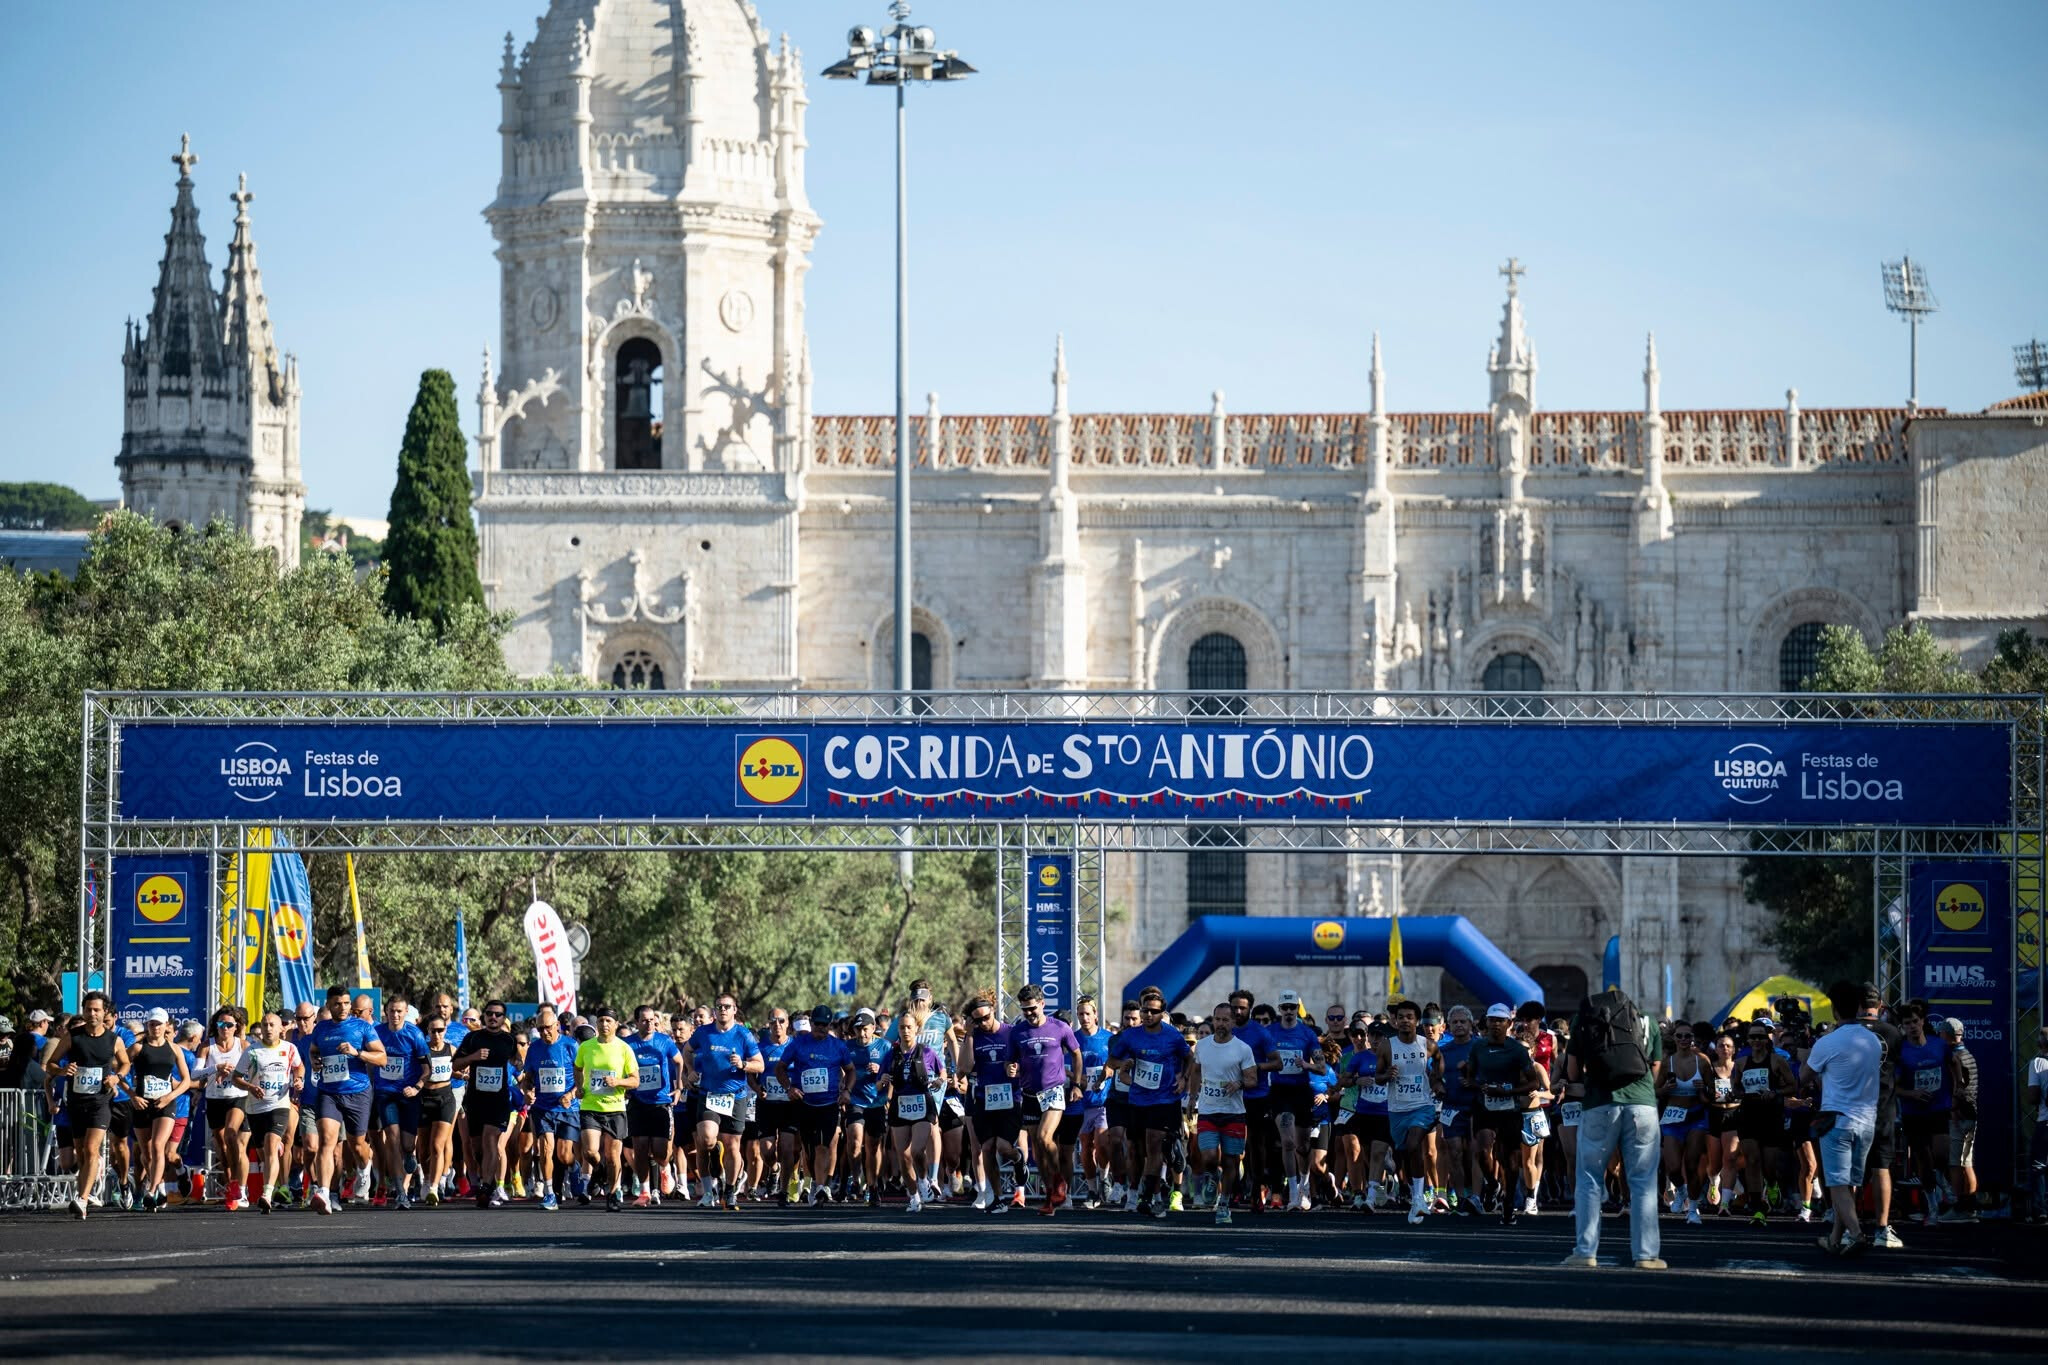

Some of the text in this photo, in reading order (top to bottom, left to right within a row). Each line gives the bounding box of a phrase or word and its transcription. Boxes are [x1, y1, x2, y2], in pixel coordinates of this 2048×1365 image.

[305, 750, 379, 766] Festas de
[823, 735, 1023, 780] CORRIDA
[1148, 728, 1374, 780] ANTÓNIO
[1802, 752, 1879, 768] Festas de
[220, 758, 292, 775] LISBOA
[1714, 759, 1788, 777] LISBOA
[227, 776, 284, 787] CULTURA
[304, 768, 402, 797] Lisboa
[1722, 777, 1779, 789] CULTURA
[1801, 771, 1904, 801] Lisboa
[126, 955, 183, 973] HMS
[160, 968, 194, 977] SPORTS
[1925, 965, 1985, 983] HMS
[835, 967, 851, 994] P
[1960, 979, 1996, 988] SPORTS
[179, 1006, 189, 1014] de
[1963, 1028, 2003, 1041] isboa
[432, 1065, 451, 1074] 886
[541, 1076, 563, 1085] 4956
[803, 1076, 827, 1086] 5521
[1398, 1083, 1423, 1094] 3754
[987, 1092, 1011, 1103] 3811
[900, 1102, 925, 1113] 3805
